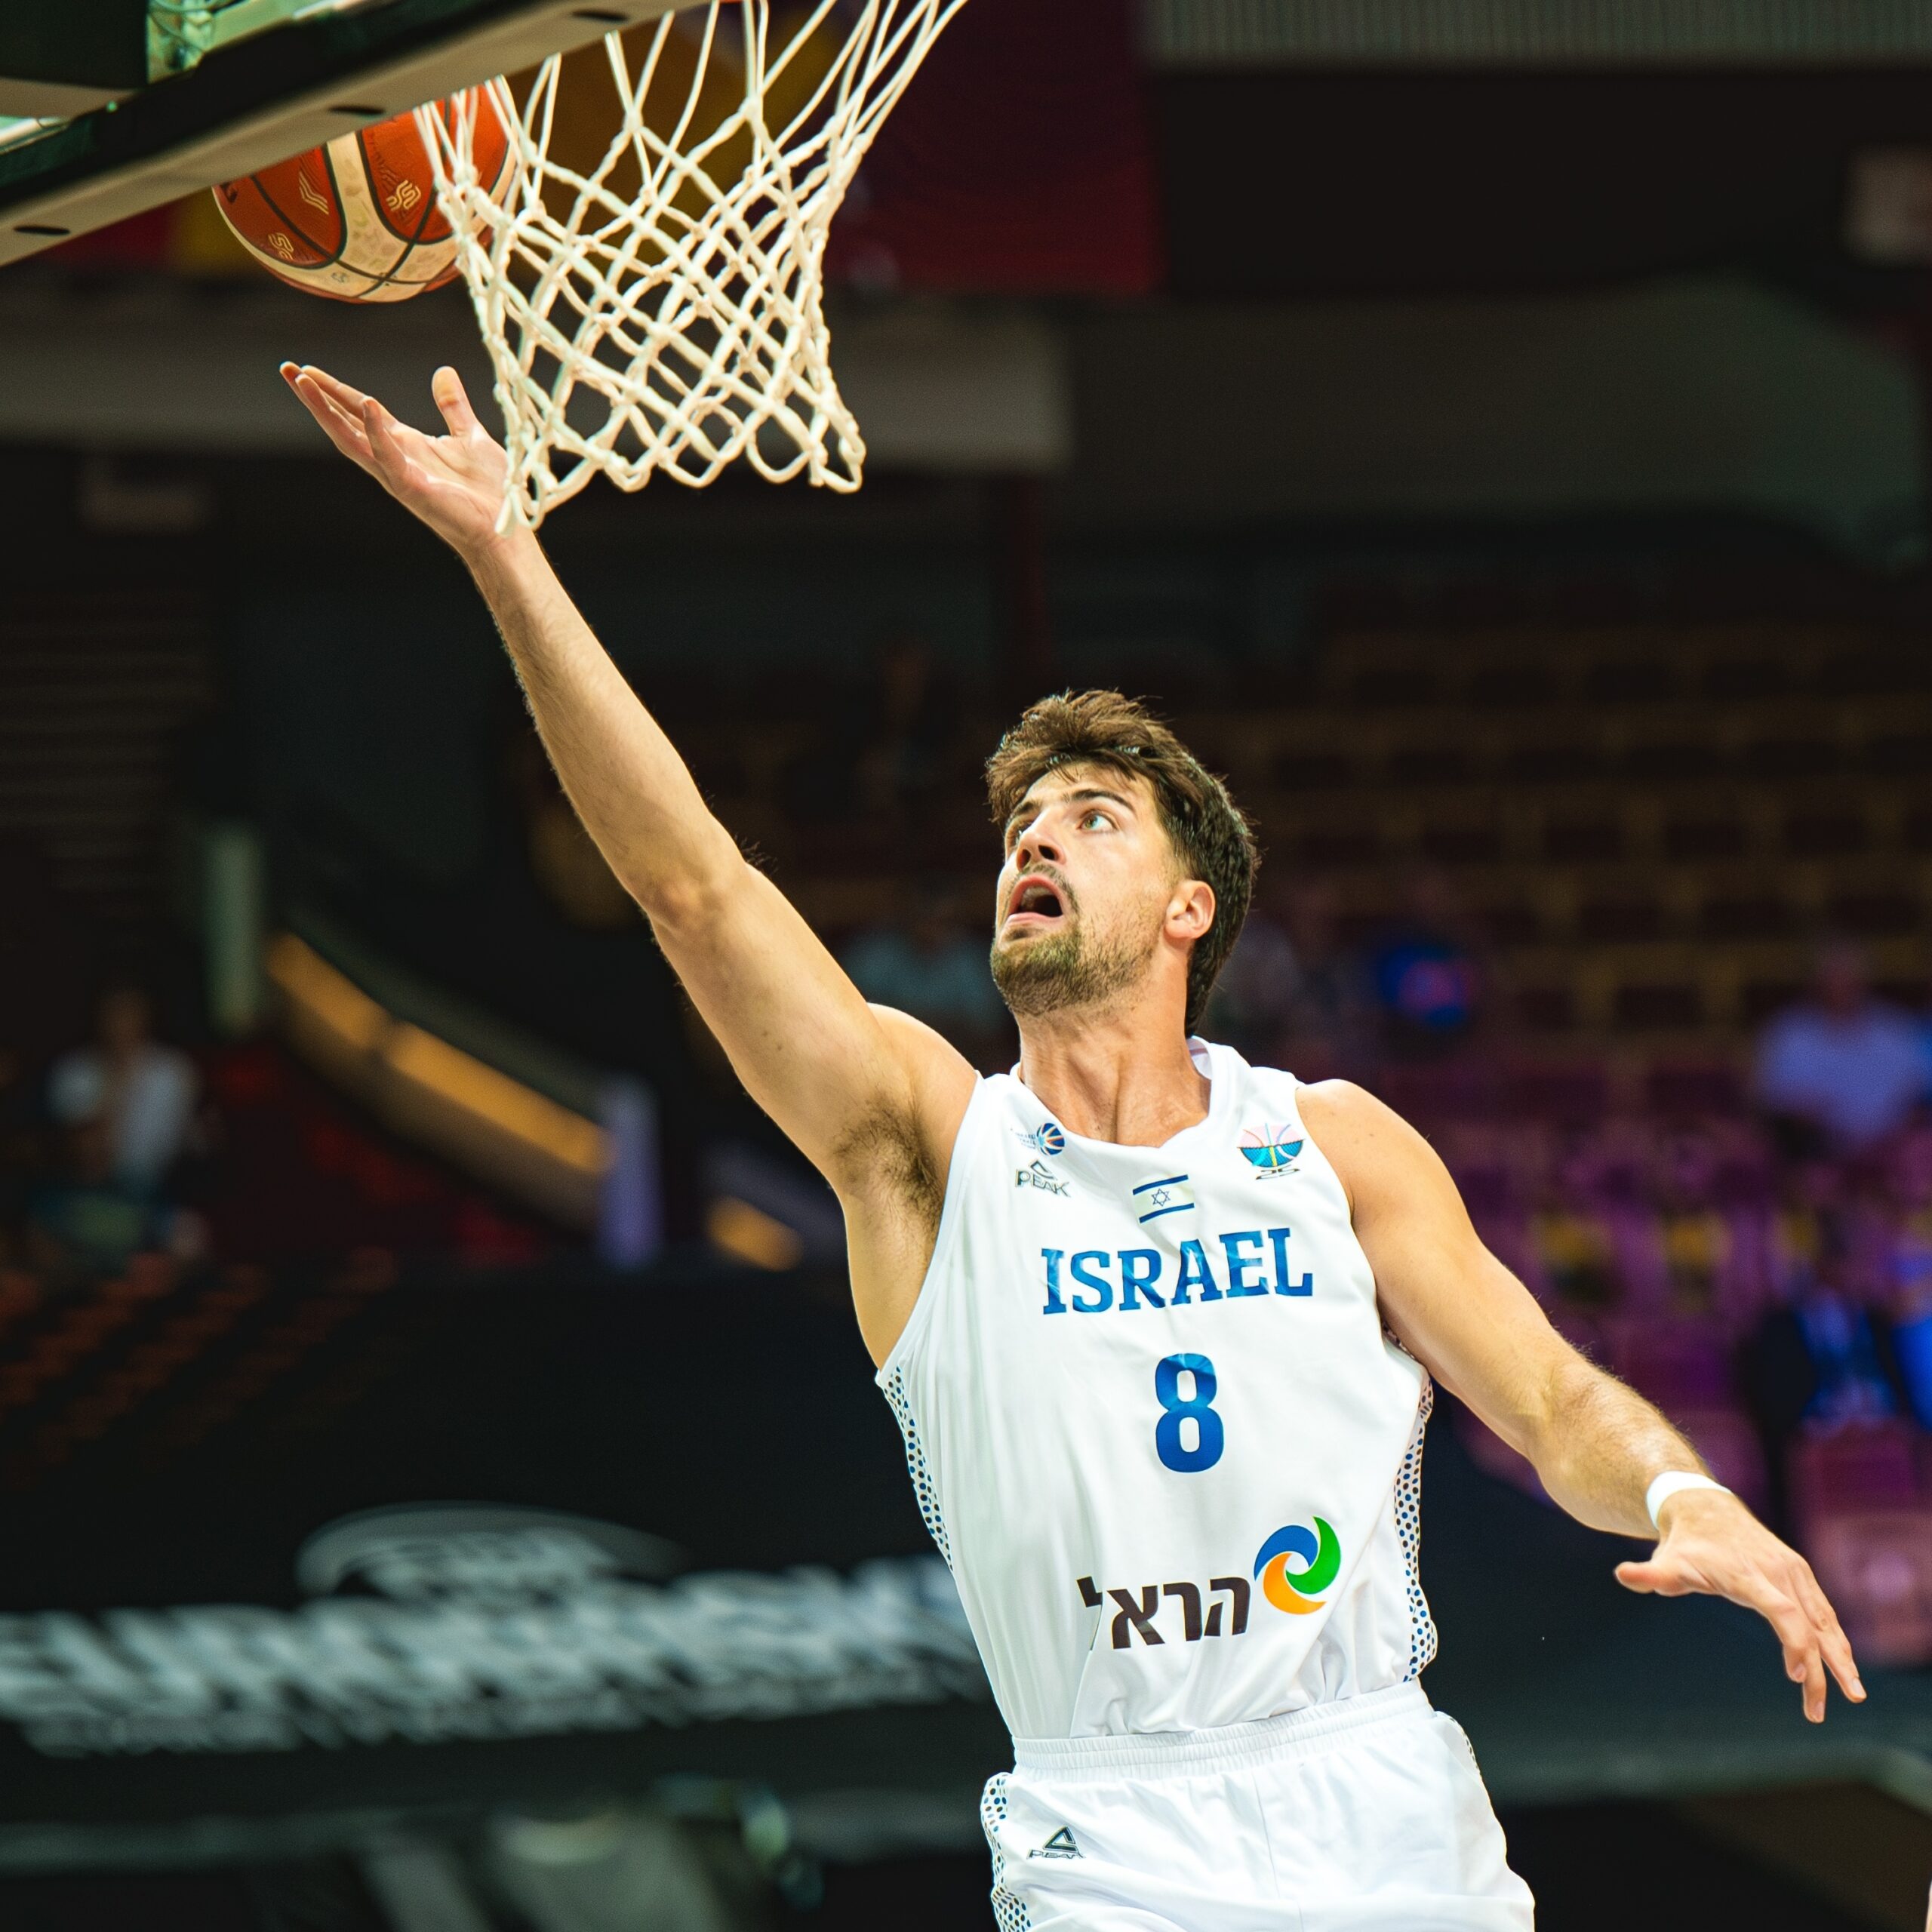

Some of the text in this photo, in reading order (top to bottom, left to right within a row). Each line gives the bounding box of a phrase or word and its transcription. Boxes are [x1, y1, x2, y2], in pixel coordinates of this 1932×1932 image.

[1016, 1169, 1071, 1198] PEAK
[1041, 1227, 1313, 1315] ISRAEL
[1155, 1353, 1224, 1473] 8
